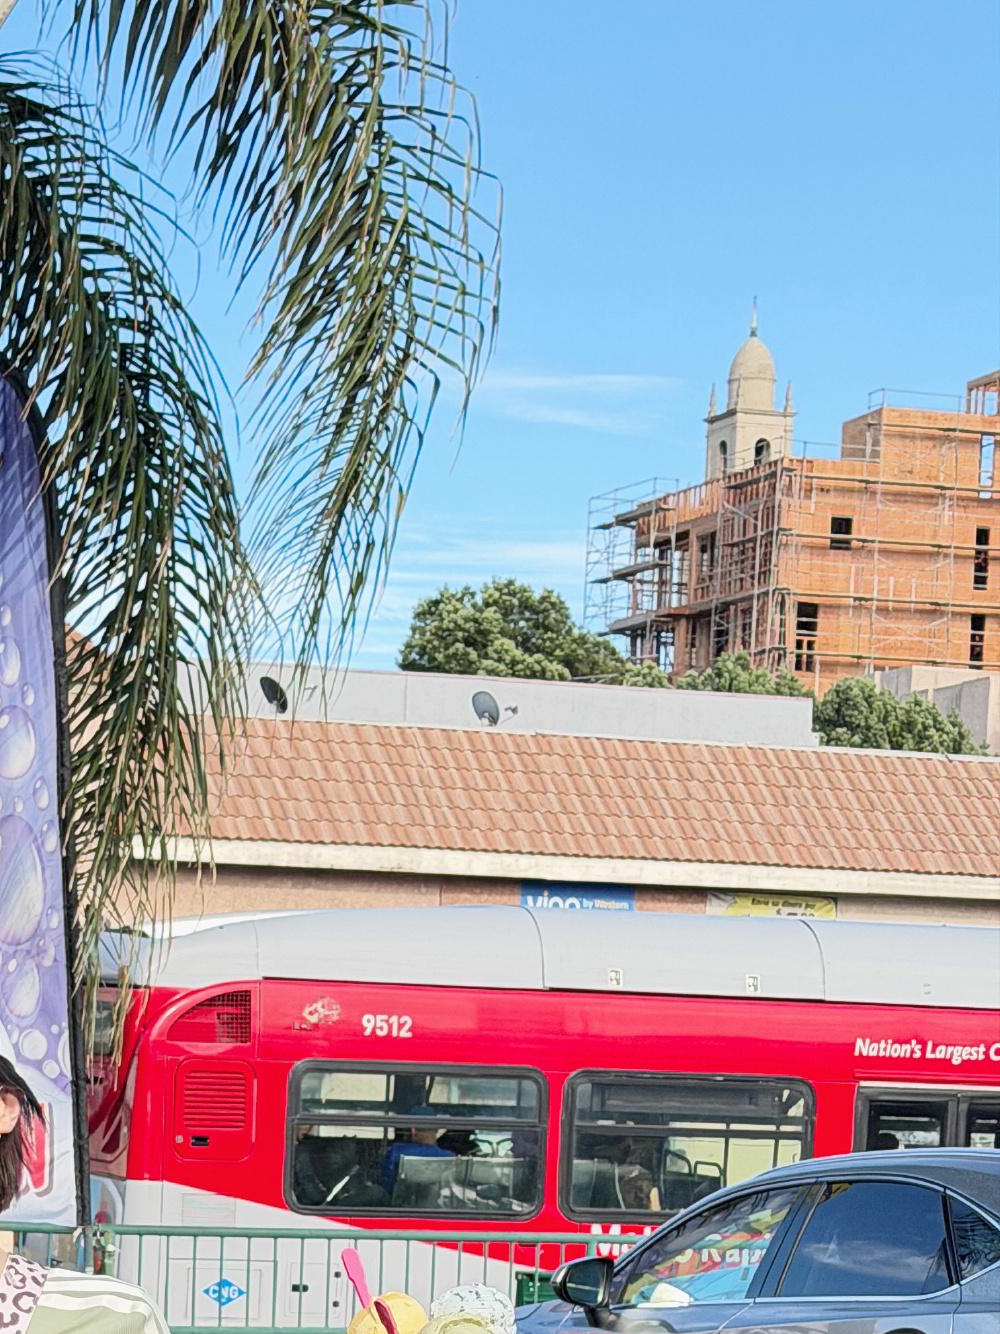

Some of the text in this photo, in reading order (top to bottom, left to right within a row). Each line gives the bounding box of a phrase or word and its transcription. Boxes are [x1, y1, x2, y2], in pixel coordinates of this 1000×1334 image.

[361, 1013, 413, 1038] 9512
[854, 1037, 922, 1059] Nation's
[925, 1040, 986, 1065] Largest
[208, 1285, 239, 1298] CNG
